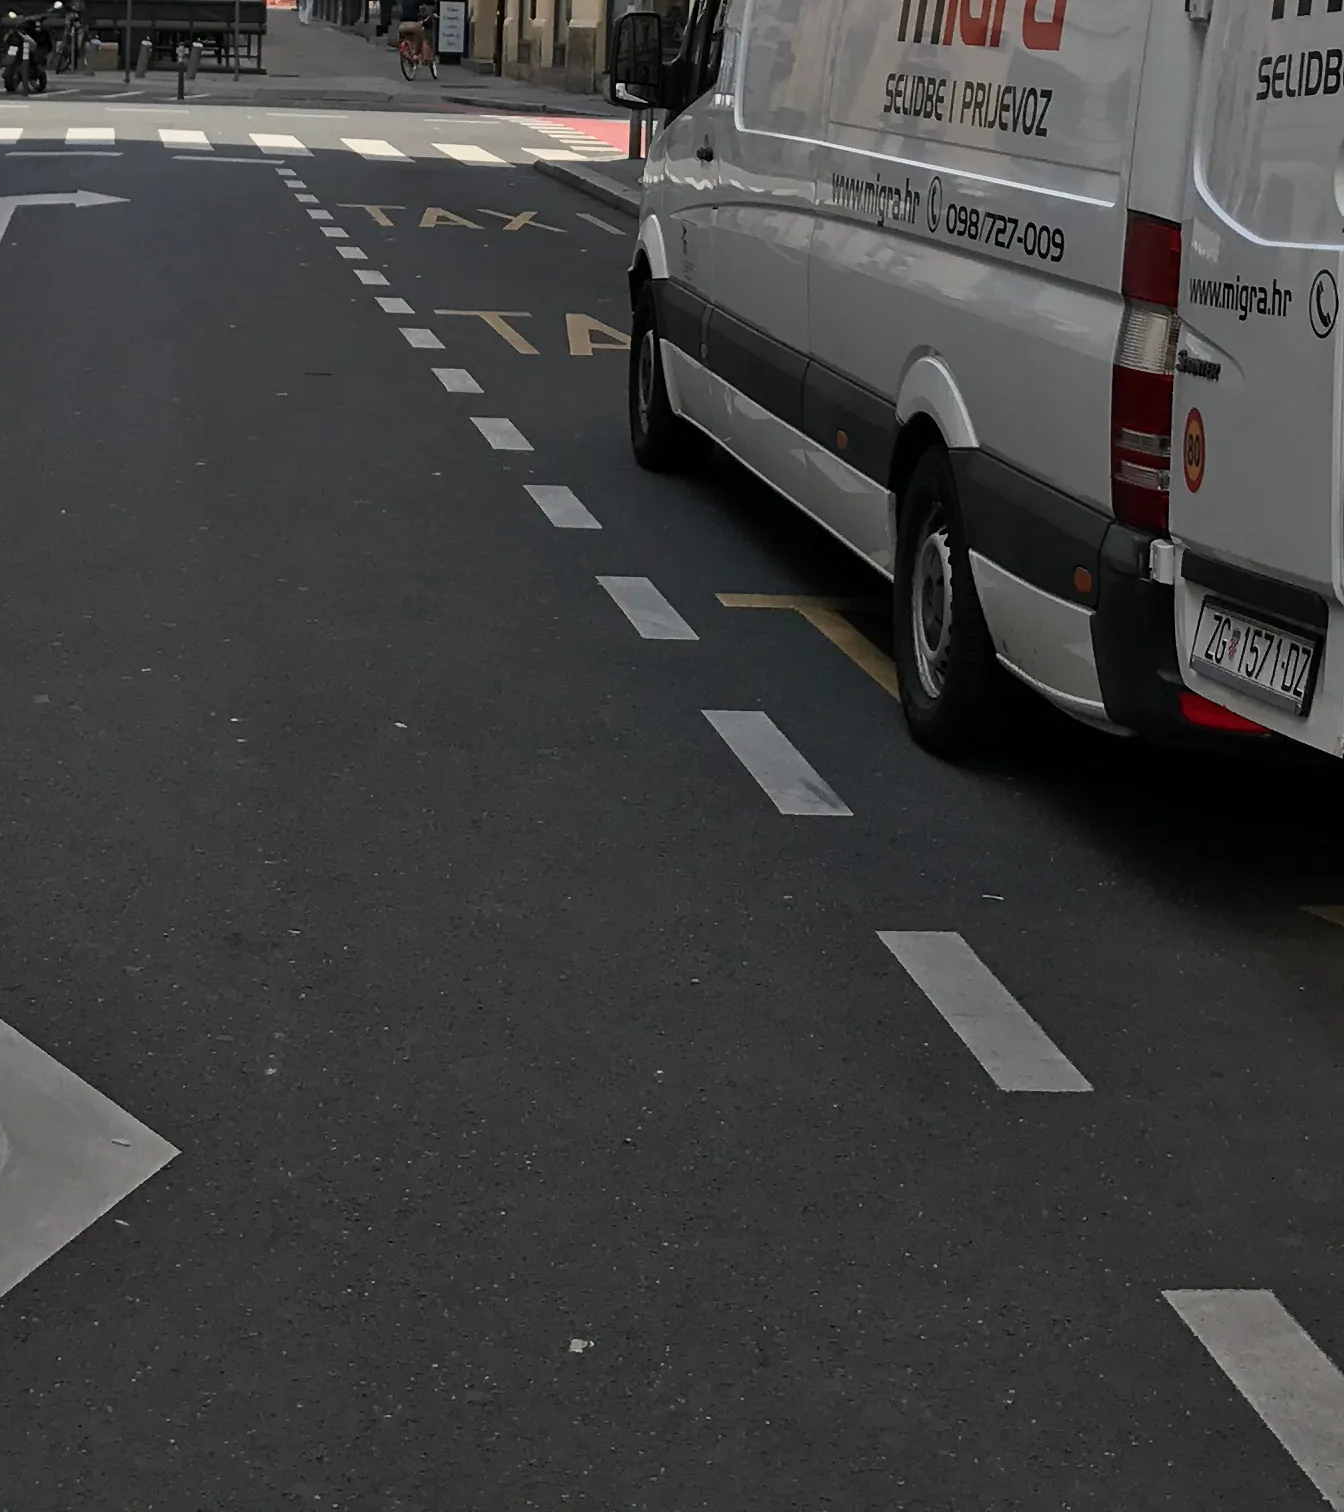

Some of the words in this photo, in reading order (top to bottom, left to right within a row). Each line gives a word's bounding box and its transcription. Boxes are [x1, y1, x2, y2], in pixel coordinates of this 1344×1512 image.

[883, 73, 947, 121] SELIDBE
[960, 80, 1053, 138] PRIJEVOZ
[336, 203, 627, 236] TAXI
[832, 173, 920, 227] www.migra.hr
[945, 203, 1065, 263] 098/727-009
[1189, 274, 1292, 322] www.migra.hr
[1187, 433, 1201, 468] 80
[1205, 614, 1232, 665] ZG
[1237, 626, 1313, 698] 1571-DZ
